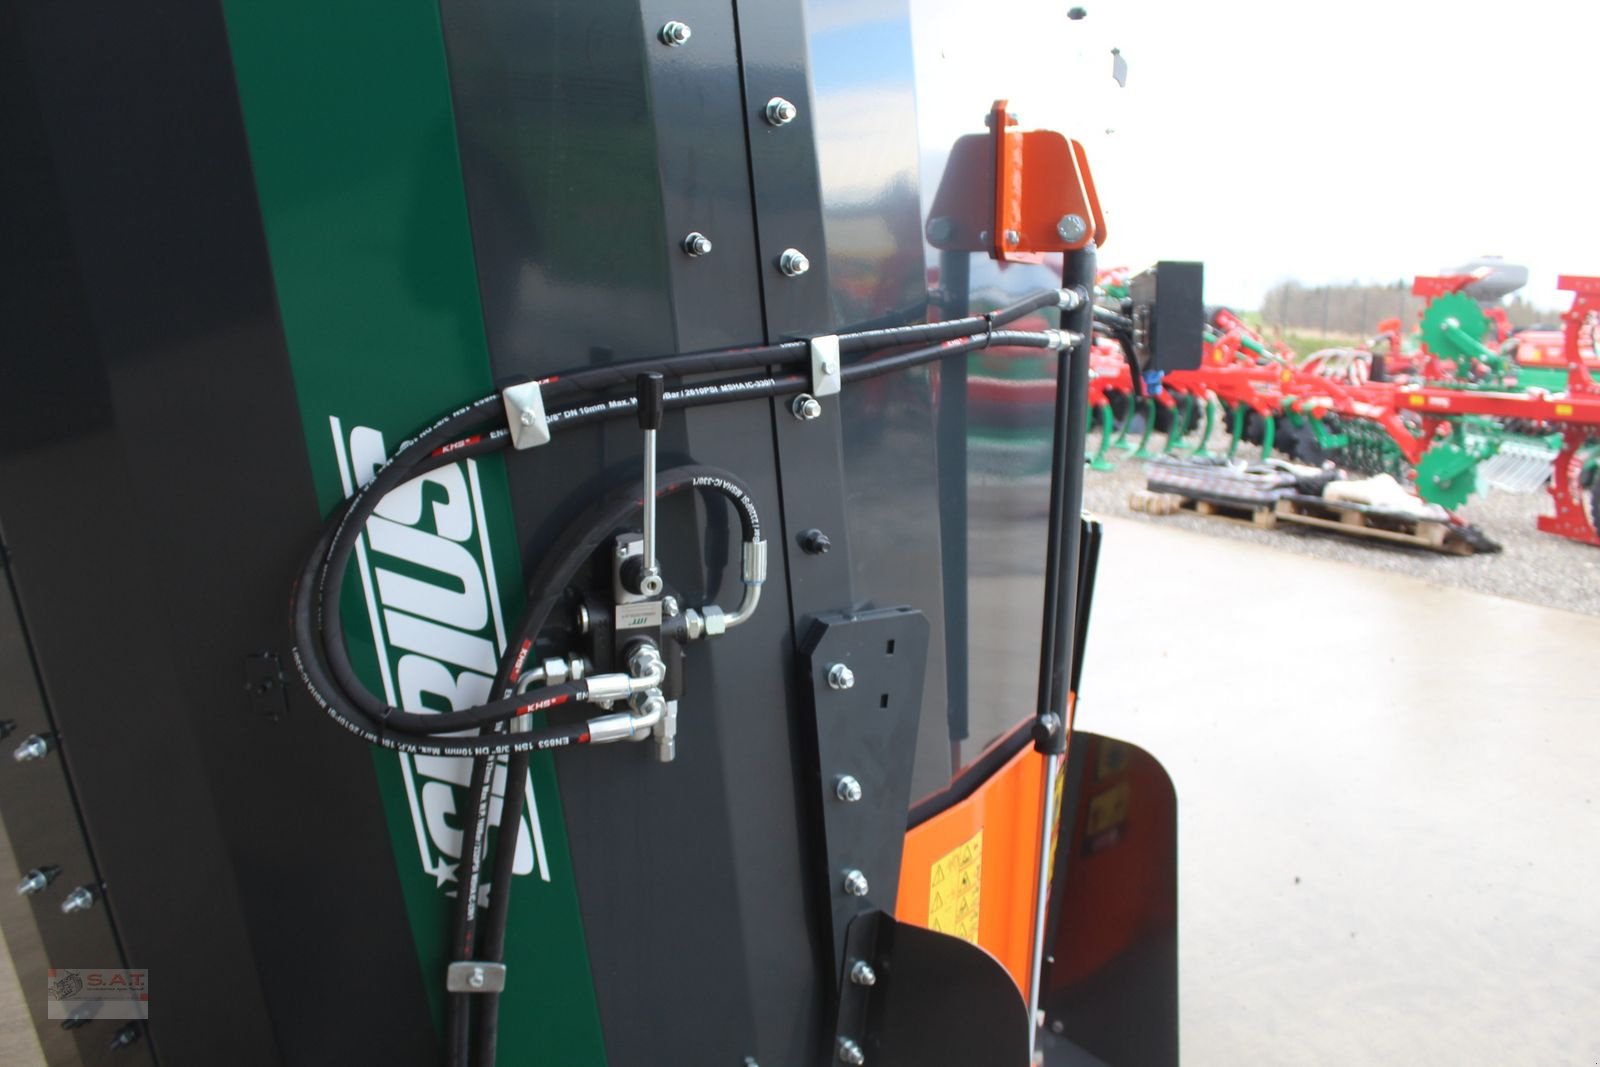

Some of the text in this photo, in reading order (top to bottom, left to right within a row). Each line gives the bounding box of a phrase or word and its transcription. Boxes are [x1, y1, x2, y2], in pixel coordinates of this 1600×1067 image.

[720, 381, 746, 392] MSHA
[563, 408, 578, 419] DN
[579, 402, 606, 415] 10mm
[608, 399, 630, 409] Max.
[723, 480, 744, 498] MSHA
[307, 681, 327, 708] MSHA
[418, 745, 440, 756] Max.
[444, 747, 473, 756] 10mm
[474, 746, 490, 756] DN
